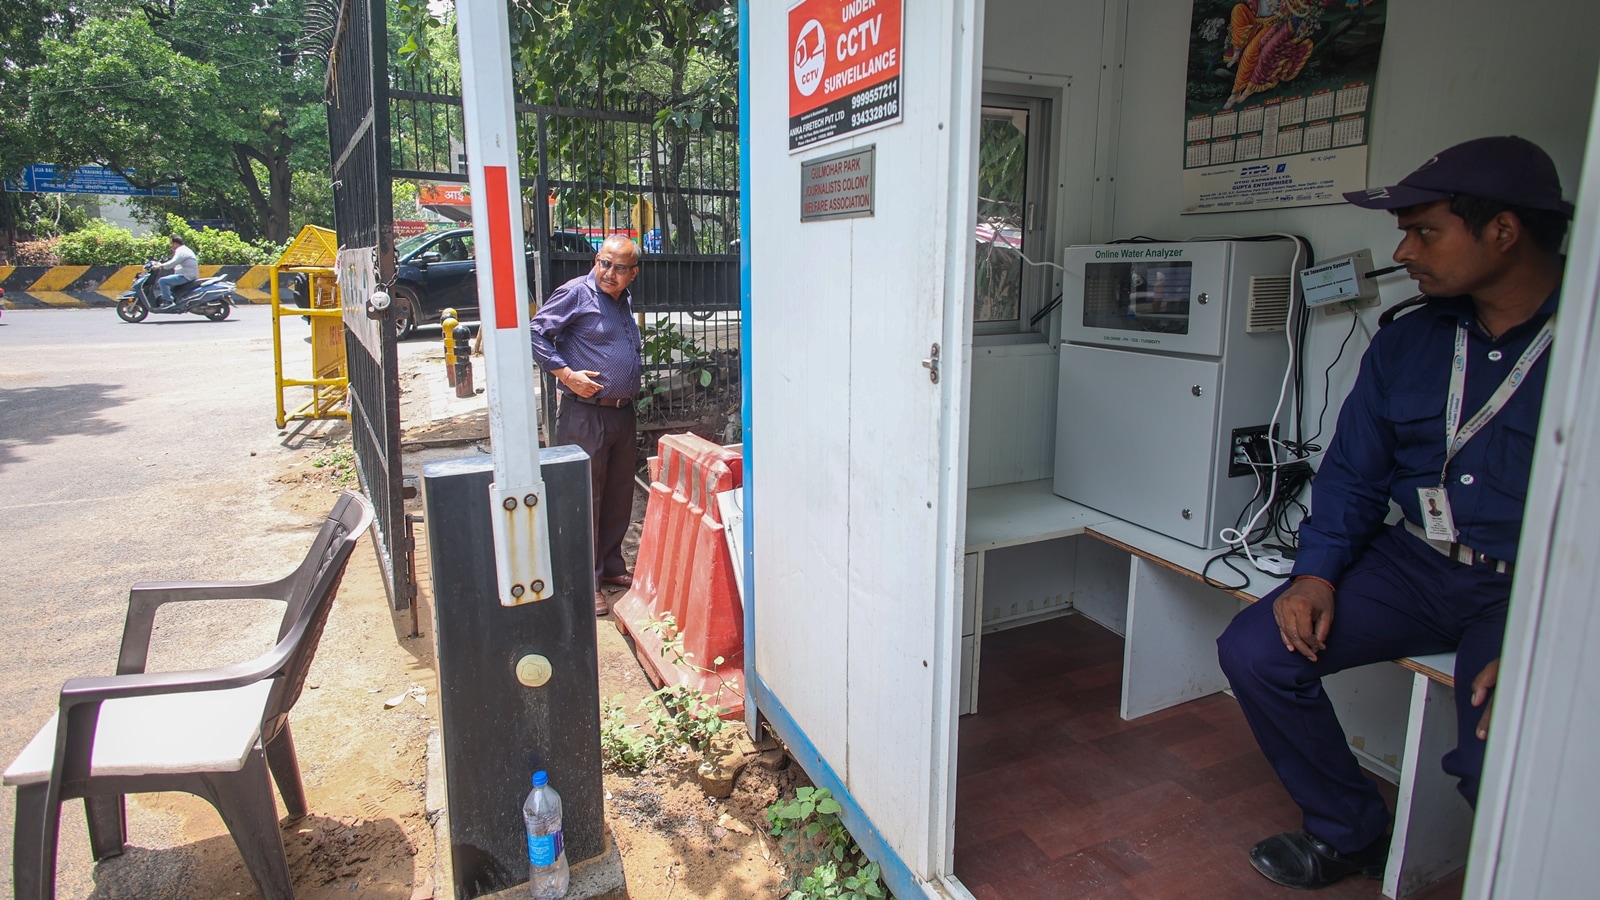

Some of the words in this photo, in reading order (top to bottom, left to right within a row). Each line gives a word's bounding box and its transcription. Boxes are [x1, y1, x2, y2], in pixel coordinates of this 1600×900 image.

[842, 0, 876, 23] UNDER
[837, 13, 882, 62] CCTV
[802, 69, 819, 85] CCTV
[824, 48, 896, 94] SURVEILLANCE
[851, 80, 898, 109] 9999557211
[824, 113, 834, 125] PVT
[834, 110, 845, 122] LTD
[851, 100, 898, 128] 9343328106
[811, 161, 842, 180] GULMOHAR
[843, 157, 861, 173] PARK
[805, 179, 842, 198] JOURNALISTS
[842, 174, 870, 191] COLONY
[1253, 179, 1293, 188] ENTERPRISES
[804, 199, 828, 214] WELFARE
[829, 193, 870, 210] ASSOCIATION
[1096, 250, 1119, 259] Online
[1120, 248, 1144, 258] Water
[1145, 247, 1184, 260] Analyzer
[1310, 265, 1332, 275] Telemetry
[1333, 261, 1350, 269] System
